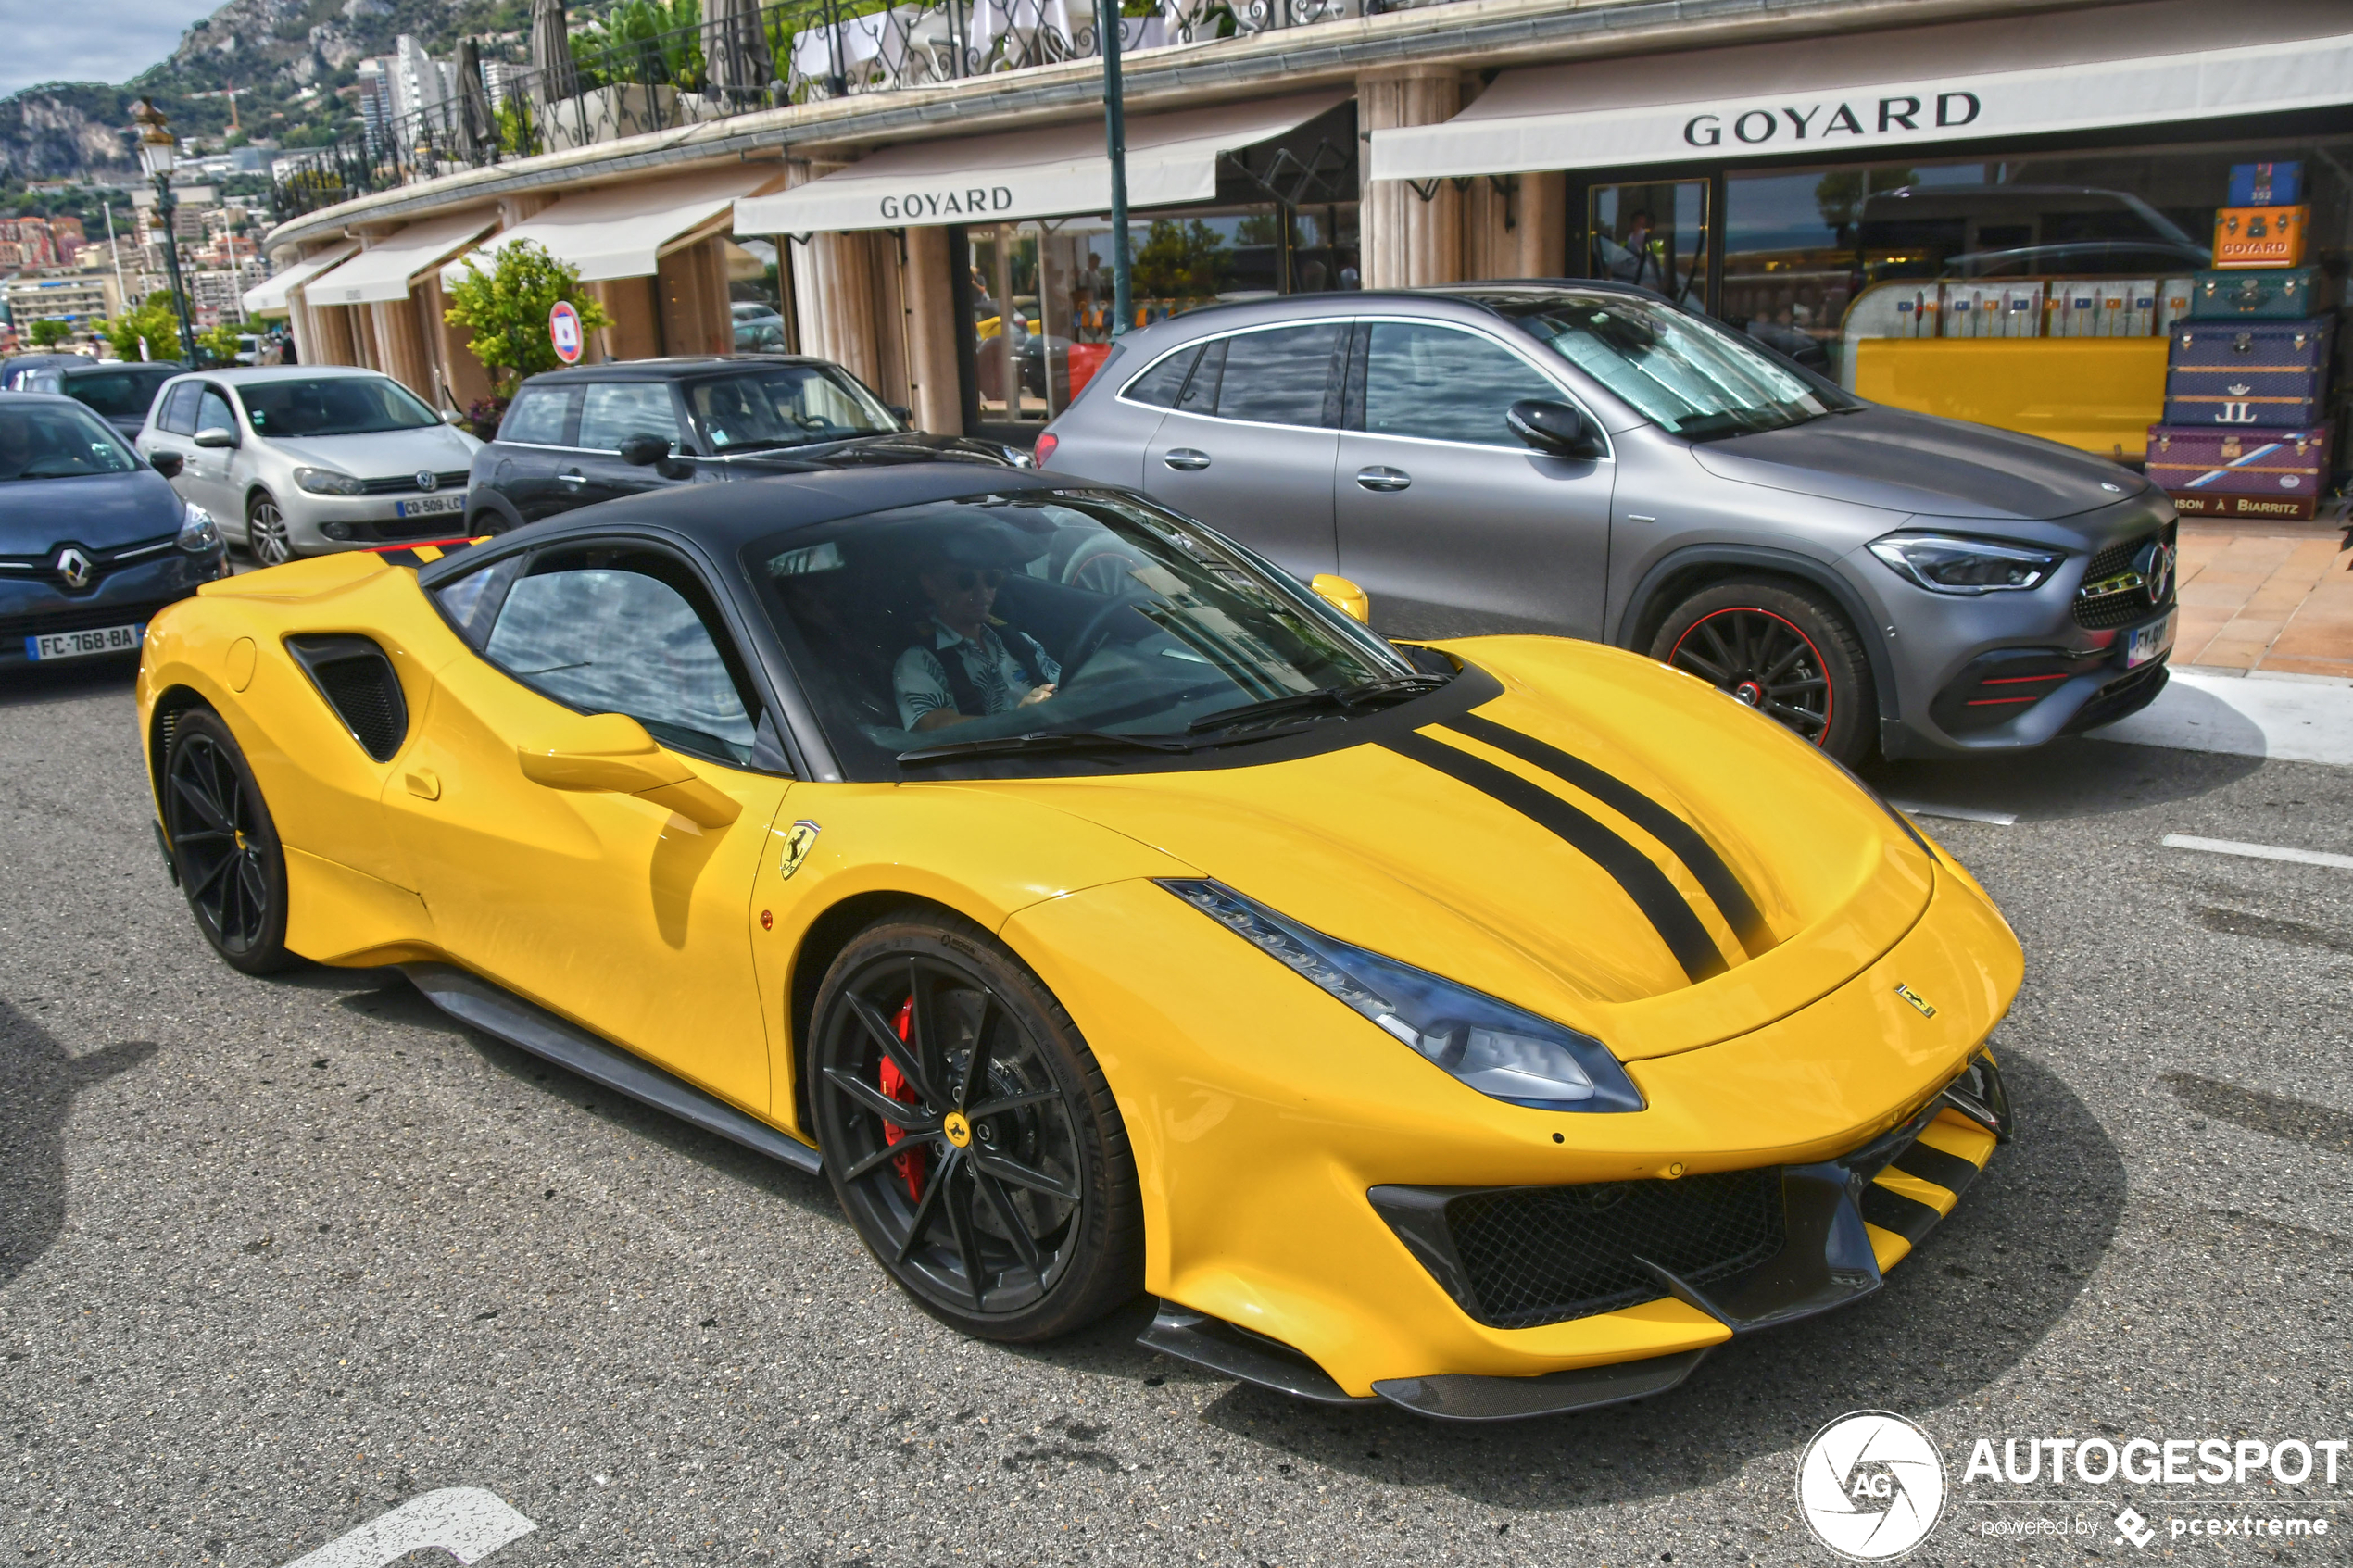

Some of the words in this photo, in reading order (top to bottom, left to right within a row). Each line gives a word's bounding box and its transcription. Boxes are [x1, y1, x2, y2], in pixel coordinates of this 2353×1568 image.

[1683, 90, 1982, 146] GOYARD
[879, 186, 1013, 219] GOYARD
[2223, 242, 2288, 256] GOYARD
[40, 628, 132, 657] FC-768-BA
